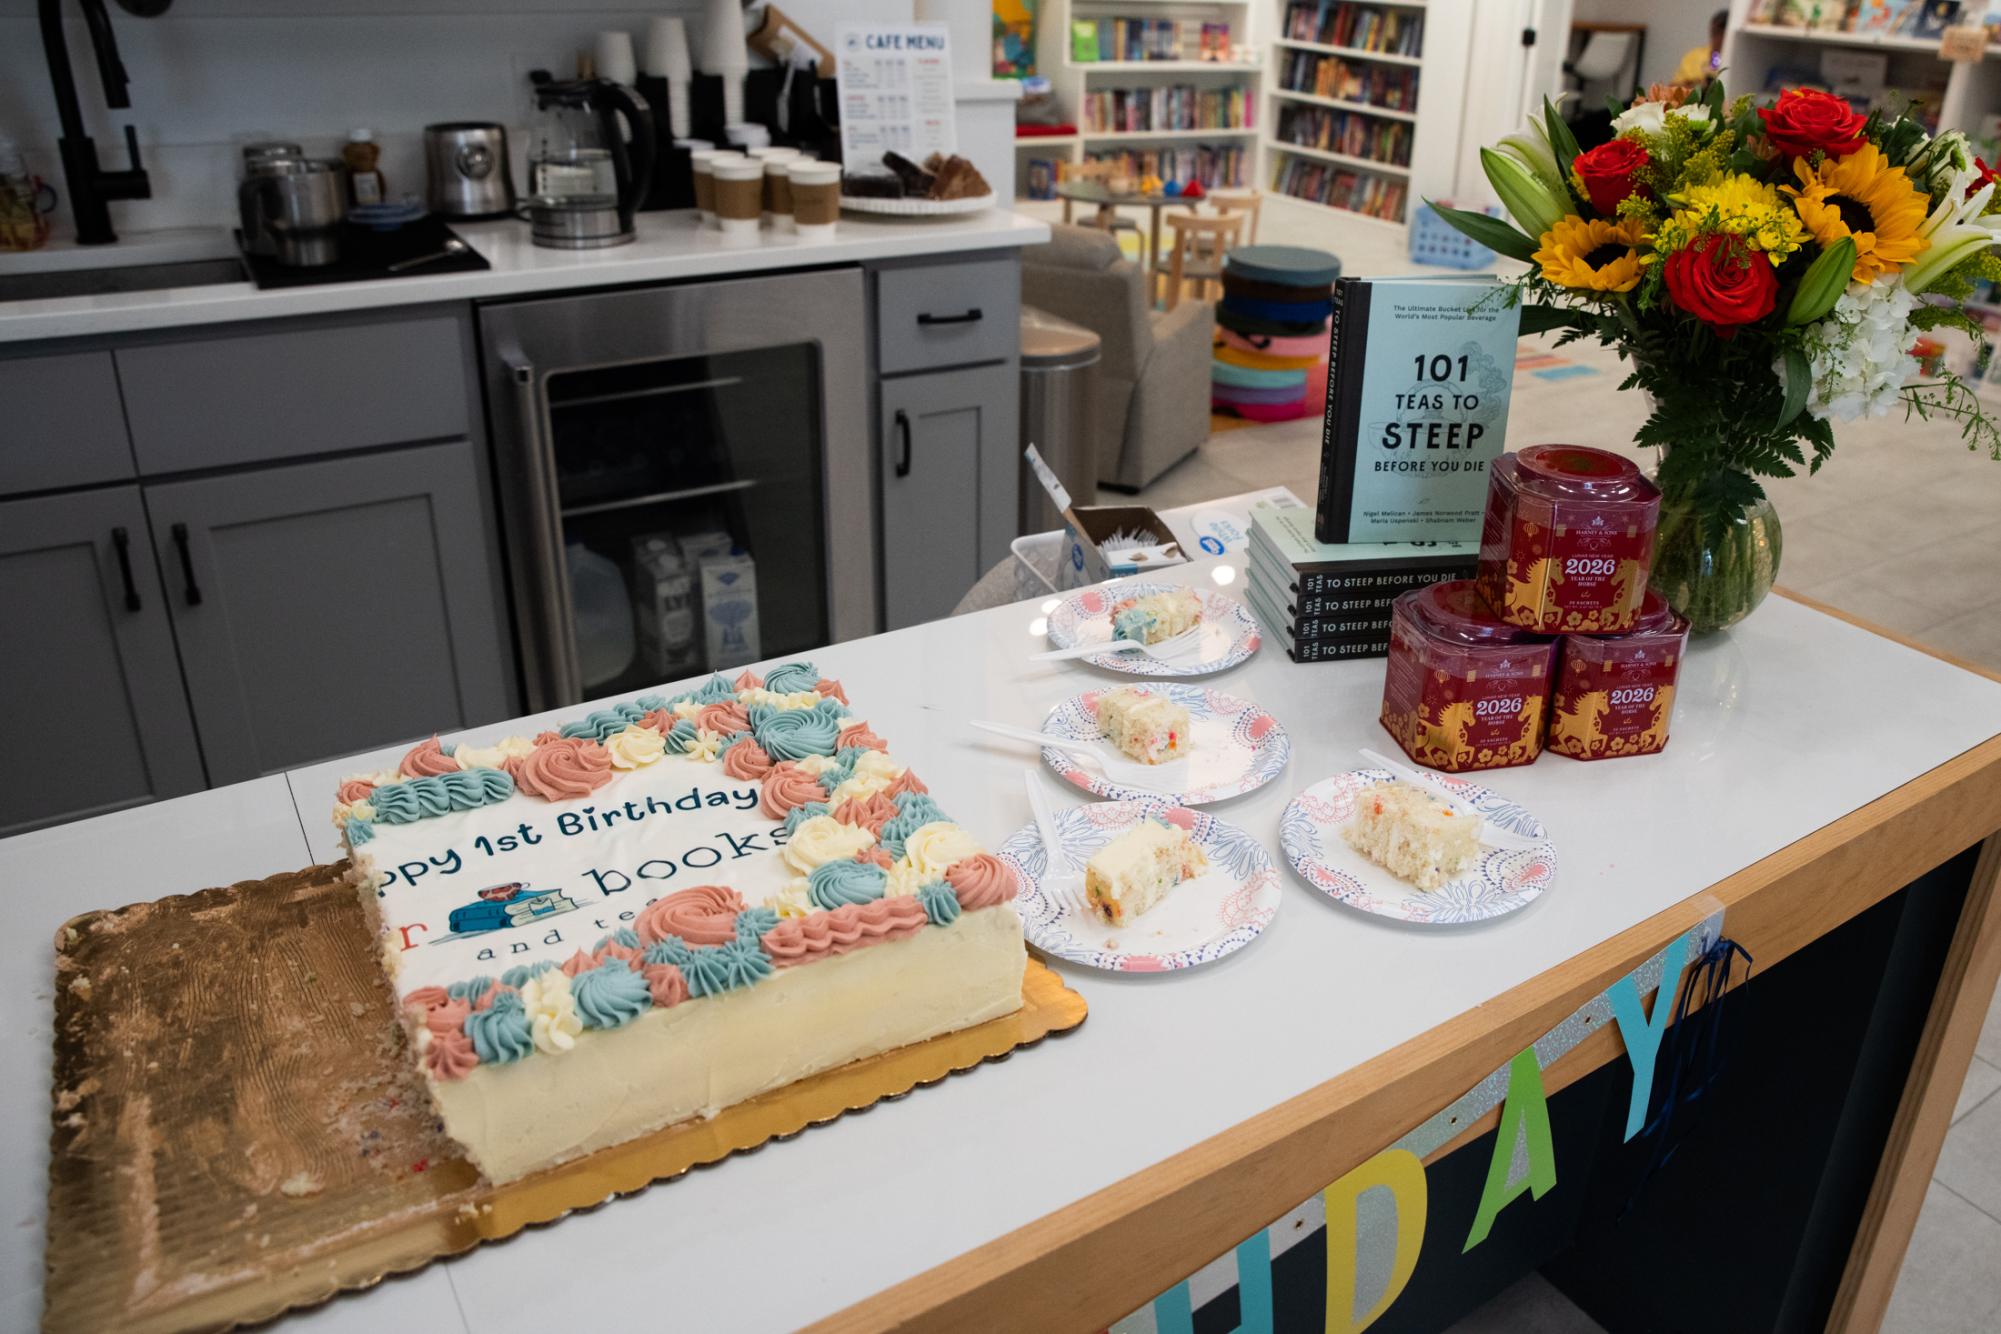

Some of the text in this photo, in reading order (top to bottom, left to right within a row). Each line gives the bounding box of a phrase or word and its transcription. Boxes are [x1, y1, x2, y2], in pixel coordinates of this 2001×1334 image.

[865, 33, 945, 51] CAFE MENU
[1440, 314, 1465, 322] Popular
[1331, 326, 1339, 359] STEEP
[1414, 354, 1468, 382] 101
[1327, 360, 1337, 401] BEFORE
[1396, 394, 1479, 410] TEAS TO
[1382, 422, 1484, 449] STEEP
[1375, 461, 1485, 472] BEFORE YOU DIE
[1565, 558, 1616, 575] 2026
[1315, 574, 1323, 593] TEAS
[1327, 579, 1341, 588] TO
[1344, 577, 1373, 587] STEEP
[1376, 576, 1414, 585] BEFORE
[1417, 573, 1438, 582] YOU
[1441, 572, 1457, 582] DIE
[1305, 601, 1313, 613] 101
[1314, 597, 1322, 616] TEAS
[1325, 602, 1339, 610] TO
[1342, 600, 1371, 609] STEEP
[1311, 619, 1319, 637] TEAS
[1322, 624, 1336, 632] TO
[1340, 622, 1368, 631] STEEP
[1311, 642, 1319, 659] TEAS
[1322, 646, 1336, 655] TO
[1340, 644, 1368, 653] STEEP
[1610, 687, 1655, 705] 2026
[1476, 697, 1522, 715] 2026
[474, 823, 543, 856] 1st
[557, 787, 758, 836] Birthday
[477, 929, 564, 961] and
